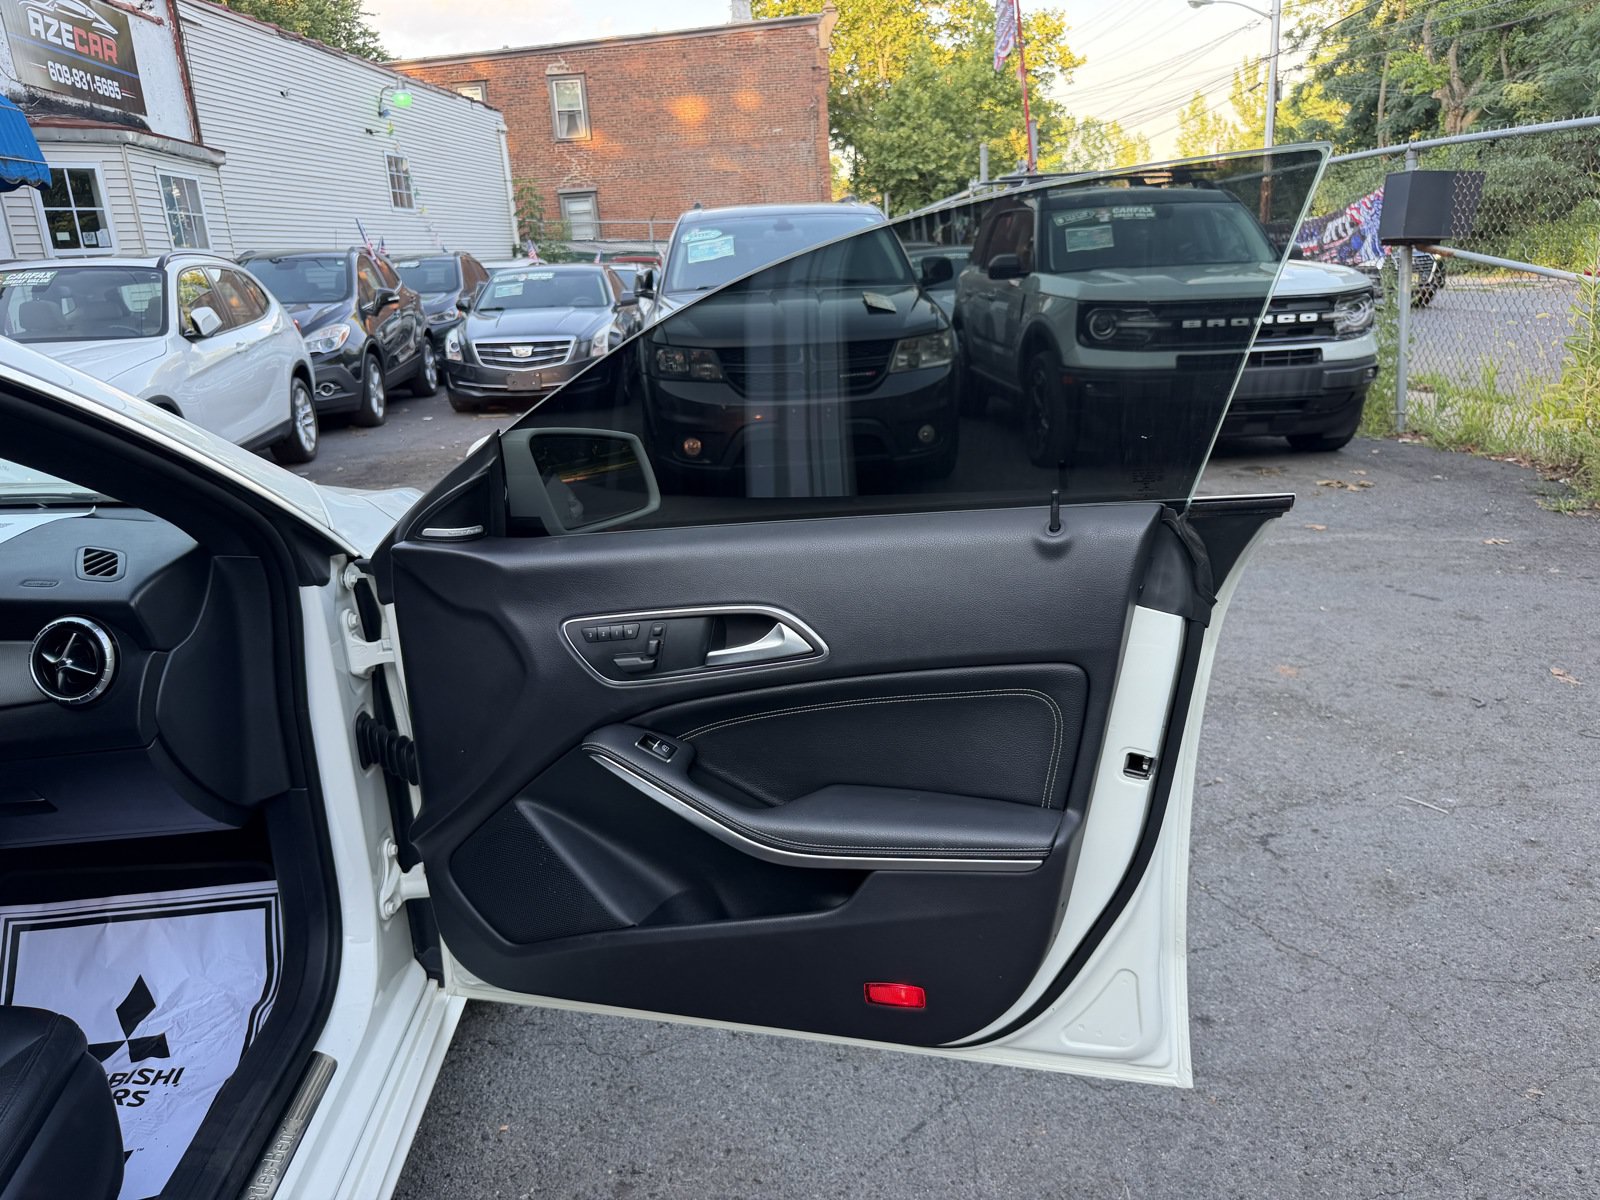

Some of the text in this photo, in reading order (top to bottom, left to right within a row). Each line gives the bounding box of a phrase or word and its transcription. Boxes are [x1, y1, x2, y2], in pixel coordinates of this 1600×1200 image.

[27, 9, 117, 64] AZECAR
[1112, 205, 1154, 214] CARFAX
[6, 271, 55, 280] CARFAX
[1182, 313, 1319, 328] BRONCO
[108, 1067, 185, 1088] BISHI
